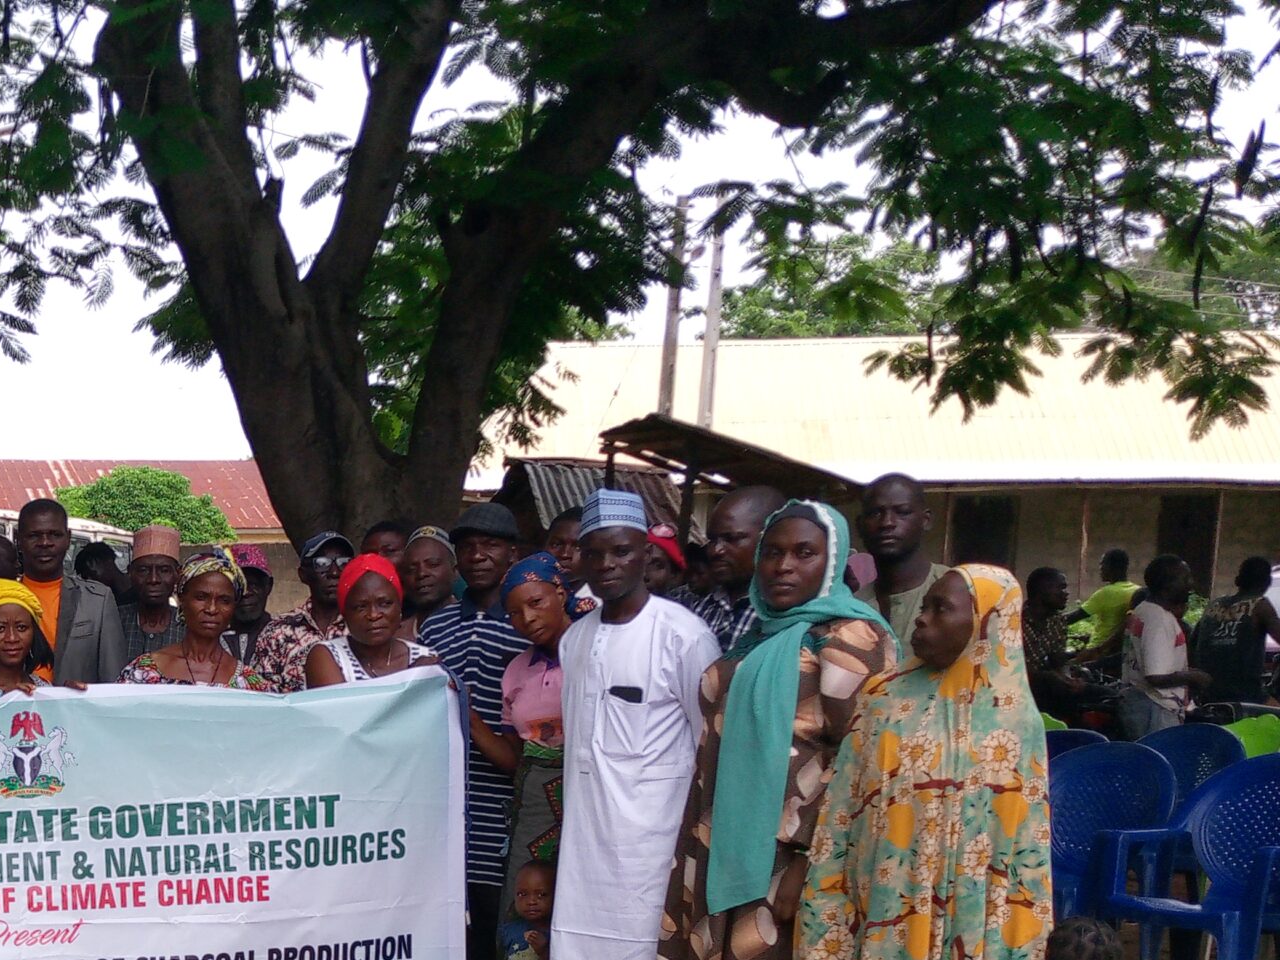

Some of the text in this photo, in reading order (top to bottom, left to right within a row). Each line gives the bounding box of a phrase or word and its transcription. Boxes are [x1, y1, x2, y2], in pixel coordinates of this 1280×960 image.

[88, 795, 340, 840] GOVERNMENT
[72, 850, 94, 880] &
[104, 842, 237, 879] NATURAL
[248, 829, 406, 872] RESOURCES
[27, 881, 146, 913] CLIMATE
[157, 875, 270, 907] CHANGE
